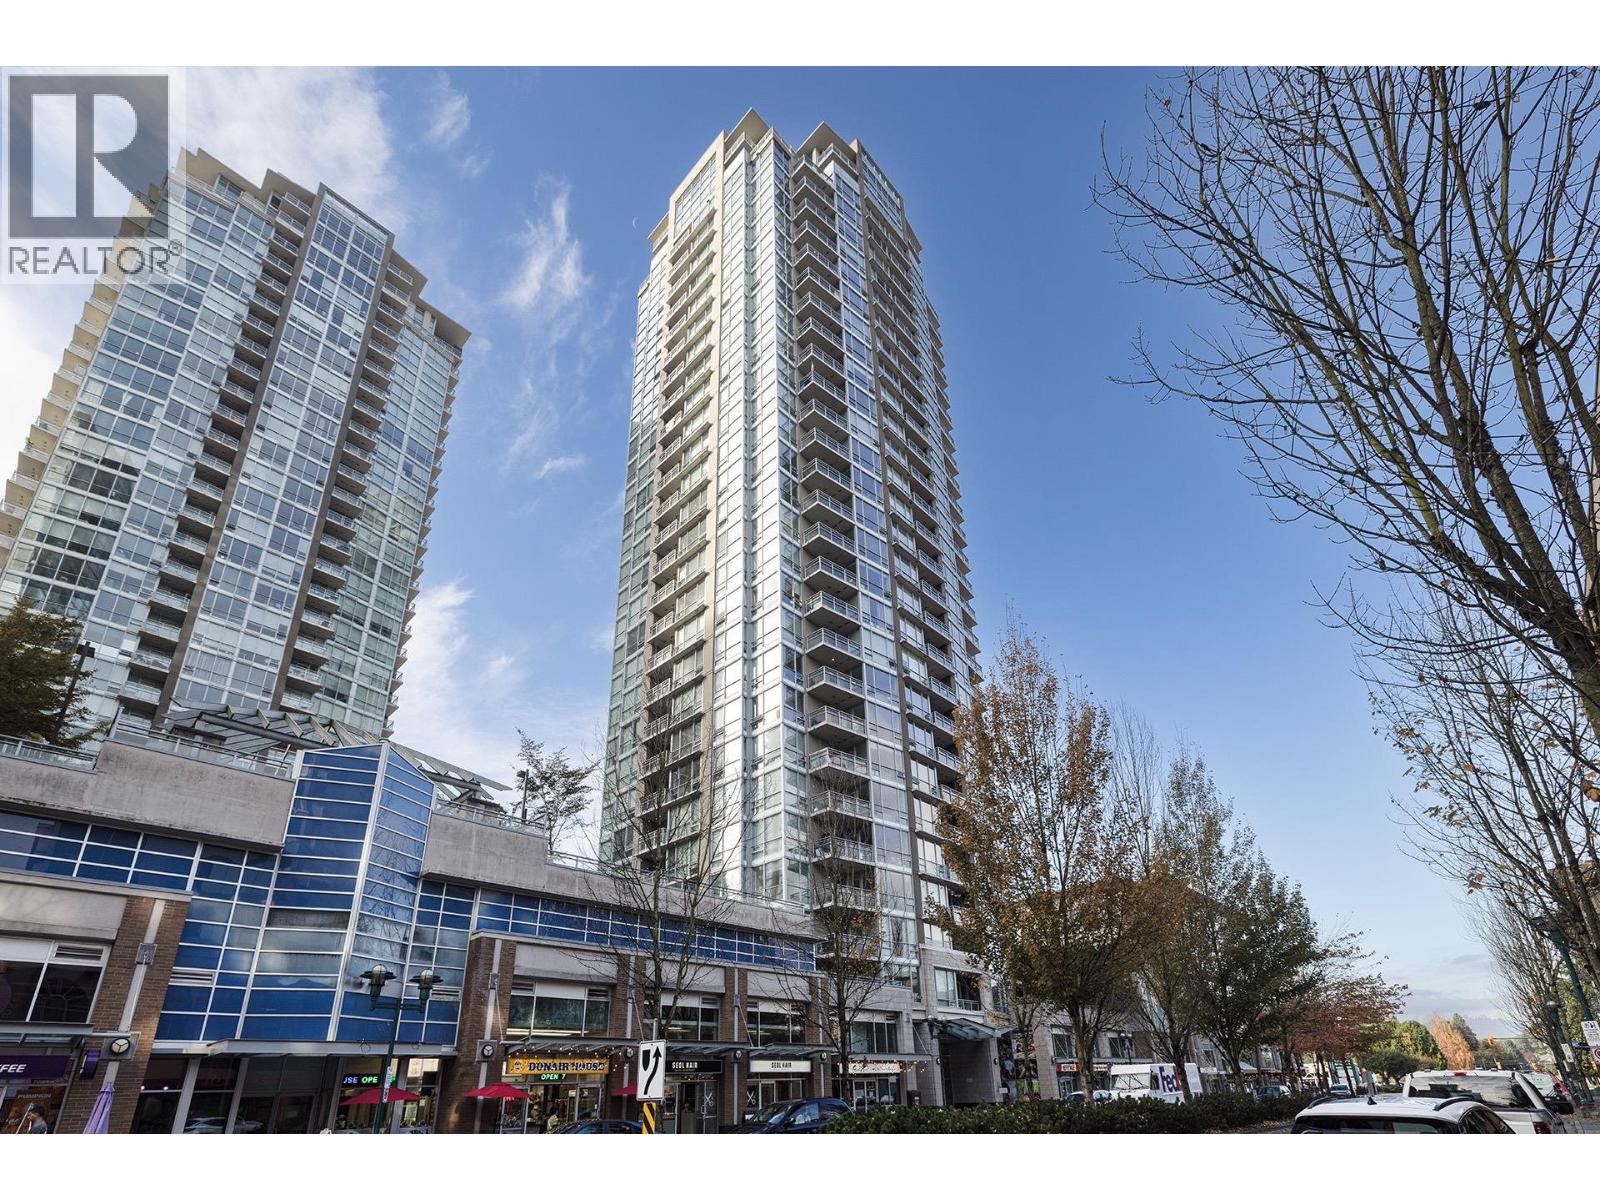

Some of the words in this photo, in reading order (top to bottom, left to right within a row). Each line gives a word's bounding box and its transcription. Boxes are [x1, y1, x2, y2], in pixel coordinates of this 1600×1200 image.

[0, 1064, 27, 1073] FEE
[528, 1062, 569, 1071] DONAIR
[570, 1062, 605, 1071] HOUSE
[361, 1076, 379, 1084] OPE
[1159, 1065, 1182, 1093] Fed
